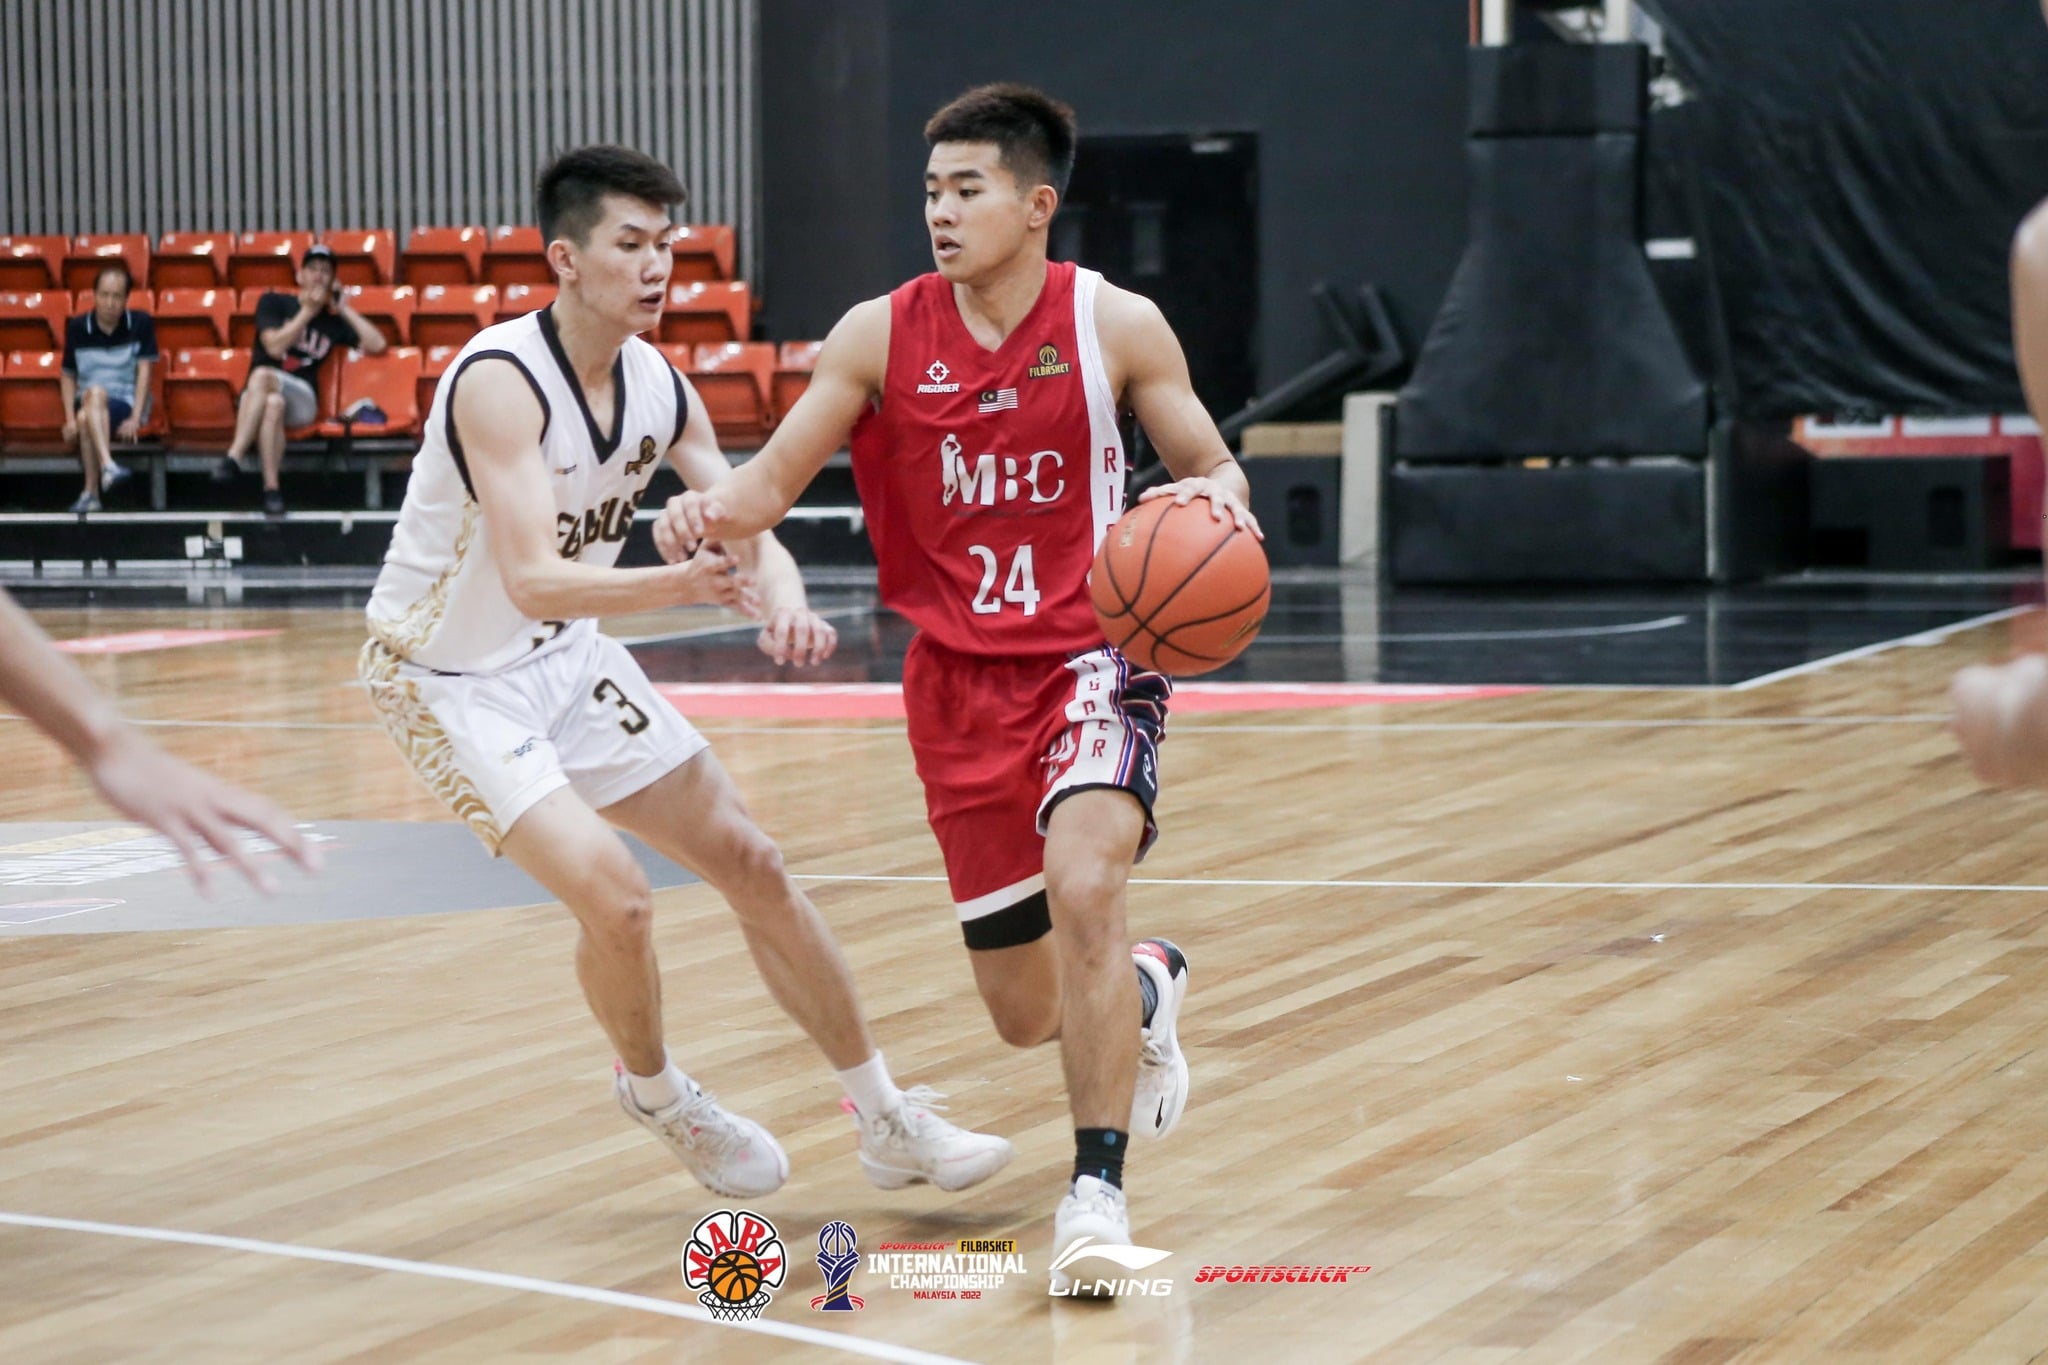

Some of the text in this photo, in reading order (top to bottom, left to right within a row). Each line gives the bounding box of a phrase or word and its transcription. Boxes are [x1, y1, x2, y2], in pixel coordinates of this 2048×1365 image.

[1029, 363, 1069, 377] FILBASKET
[917, 383, 960, 394] RIGORER
[968, 544, 1041, 616] 24
[593, 678, 650, 735] 3
